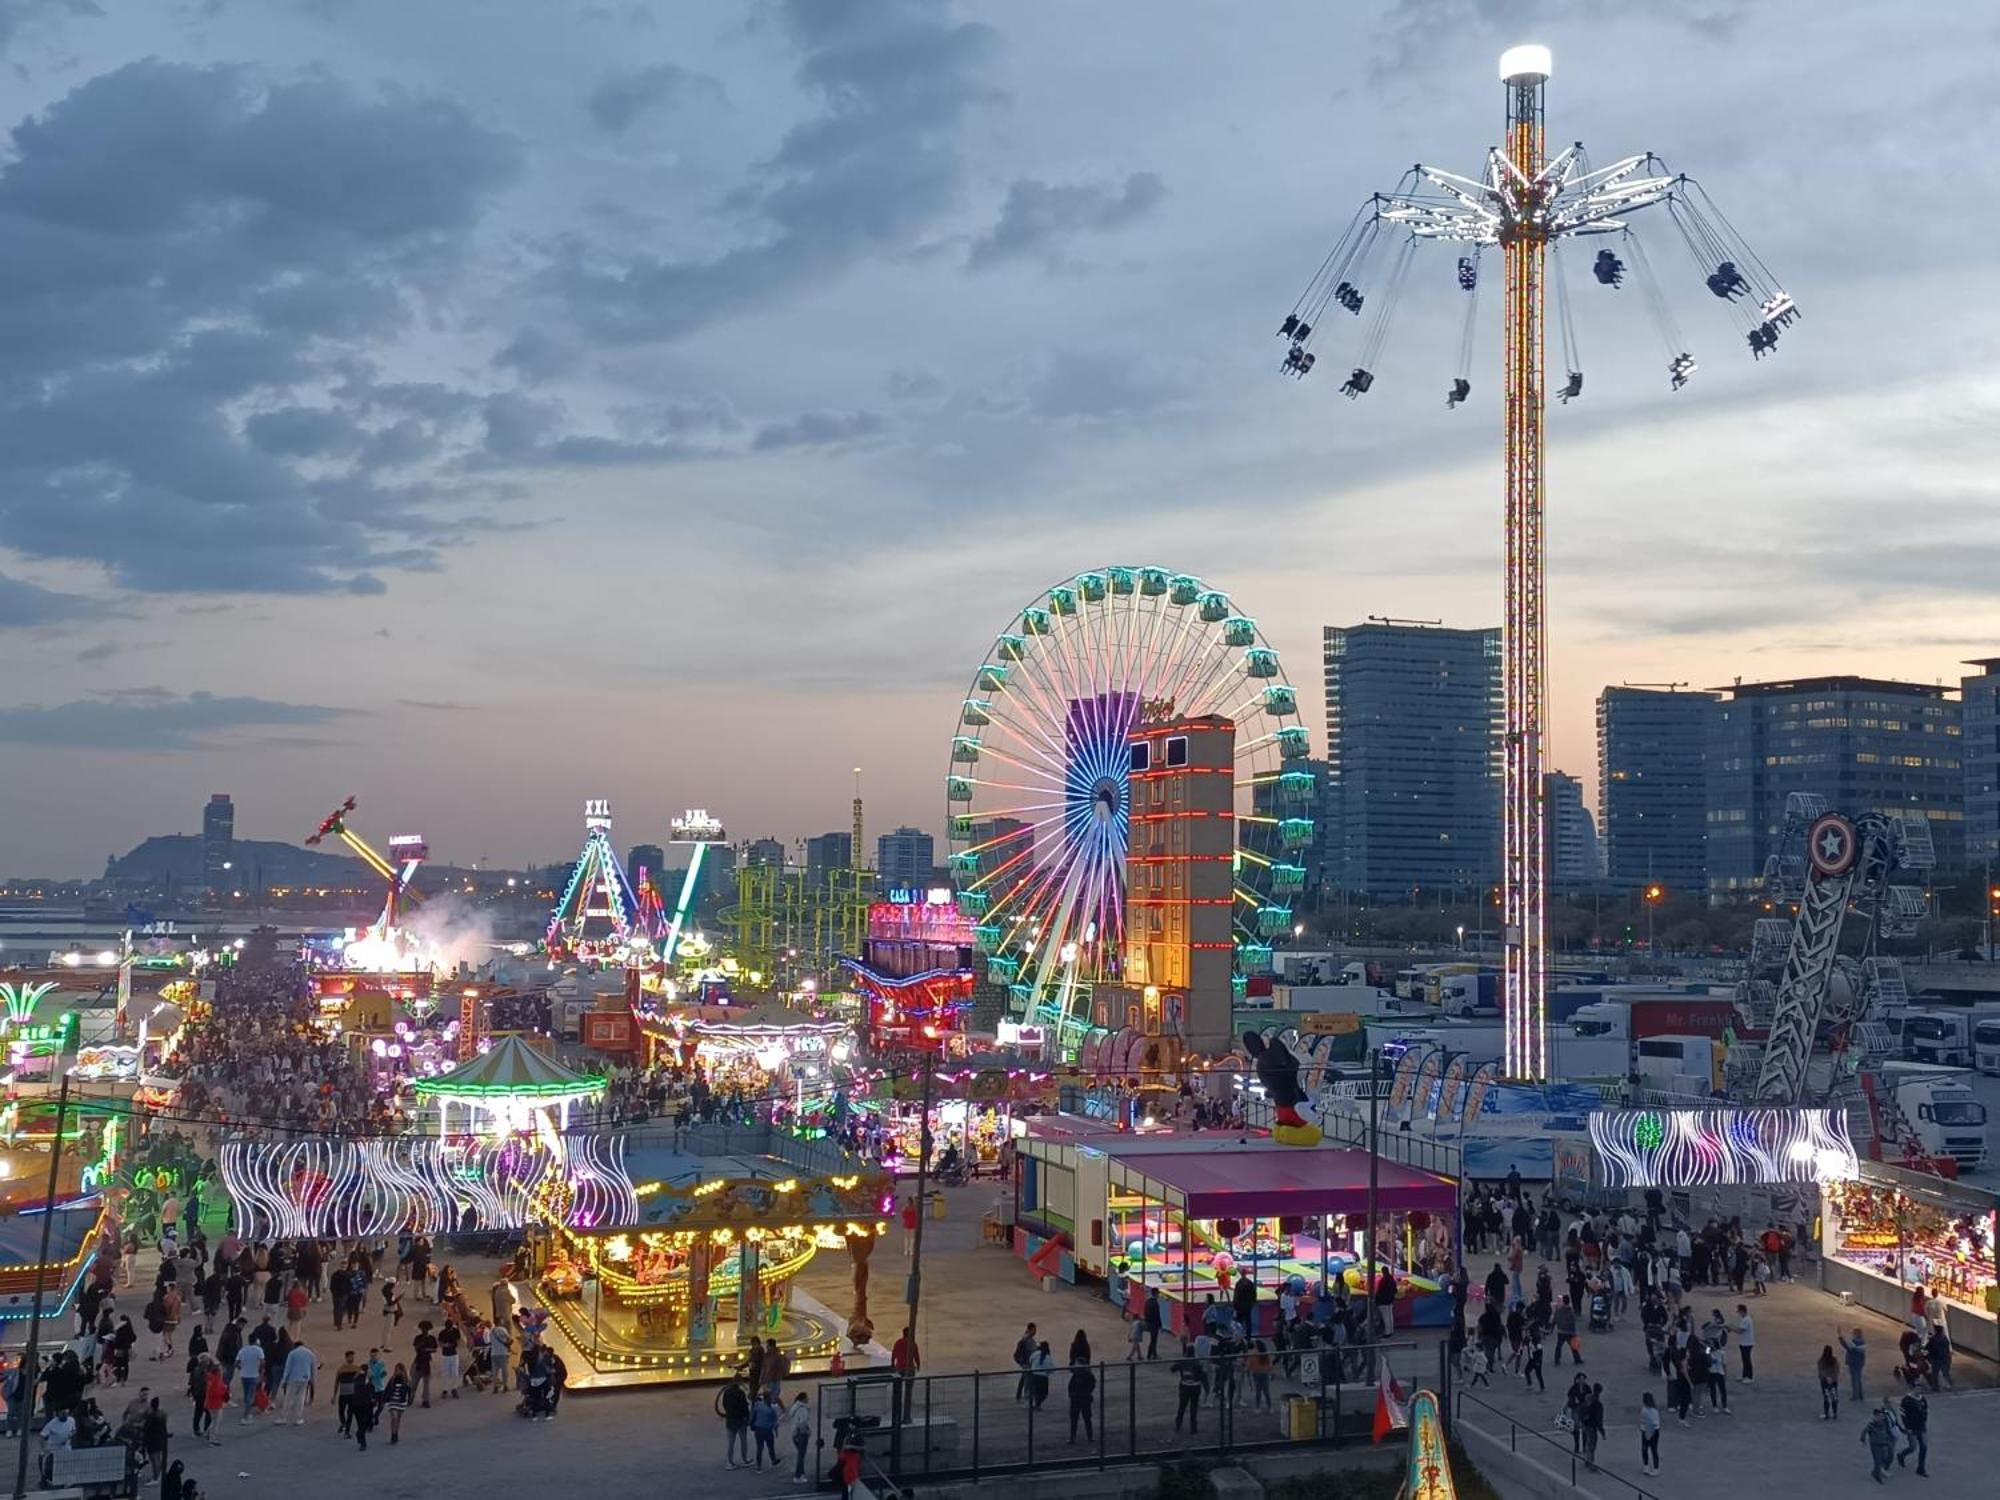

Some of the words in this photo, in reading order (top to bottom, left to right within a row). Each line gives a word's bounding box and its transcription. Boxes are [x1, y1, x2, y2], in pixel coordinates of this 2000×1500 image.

[585, 800, 609, 815] XXL
[890, 889, 910, 903] CASA
[1666, 1012, 1687, 1026] Mr.
